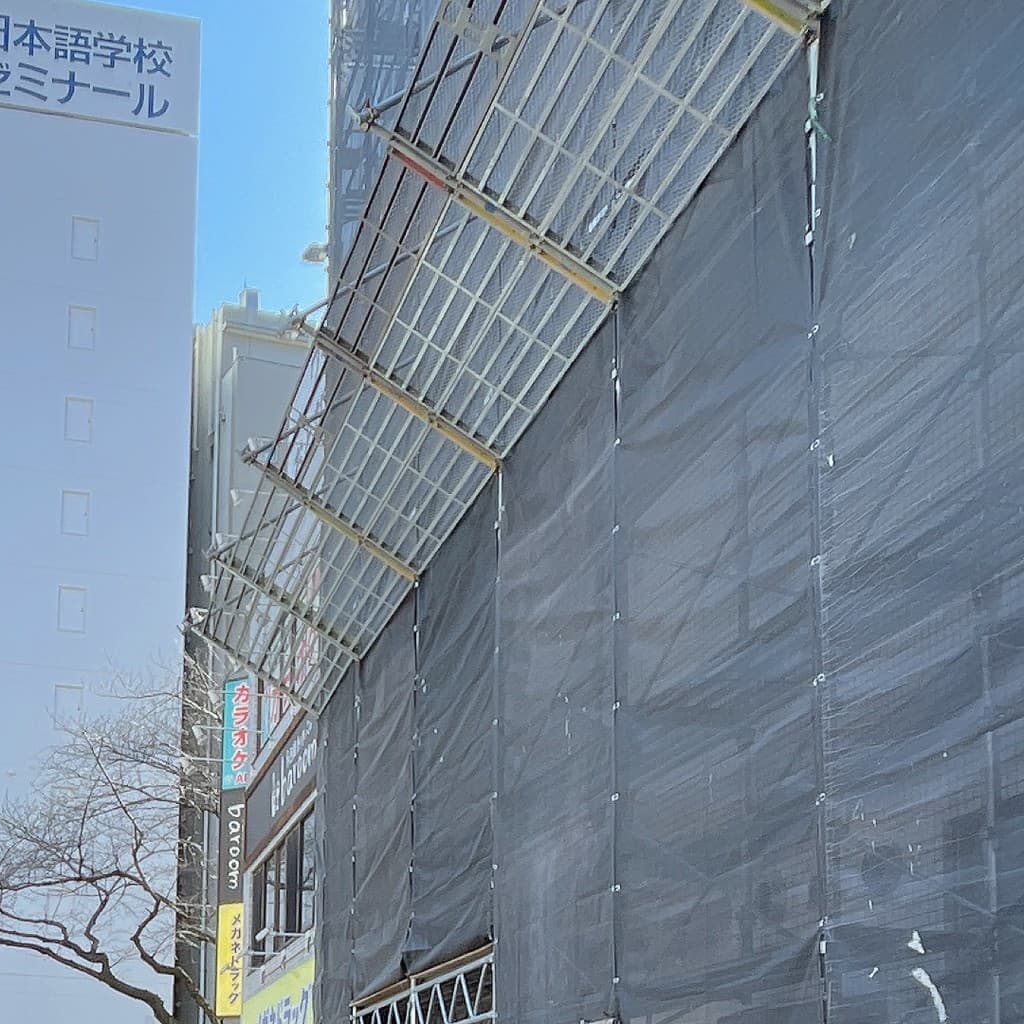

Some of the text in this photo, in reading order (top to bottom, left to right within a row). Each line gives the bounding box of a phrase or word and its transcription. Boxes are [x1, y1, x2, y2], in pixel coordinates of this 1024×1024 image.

[232, 684, 250, 770] カラオケ
[227, 803, 245, 890] baroom
